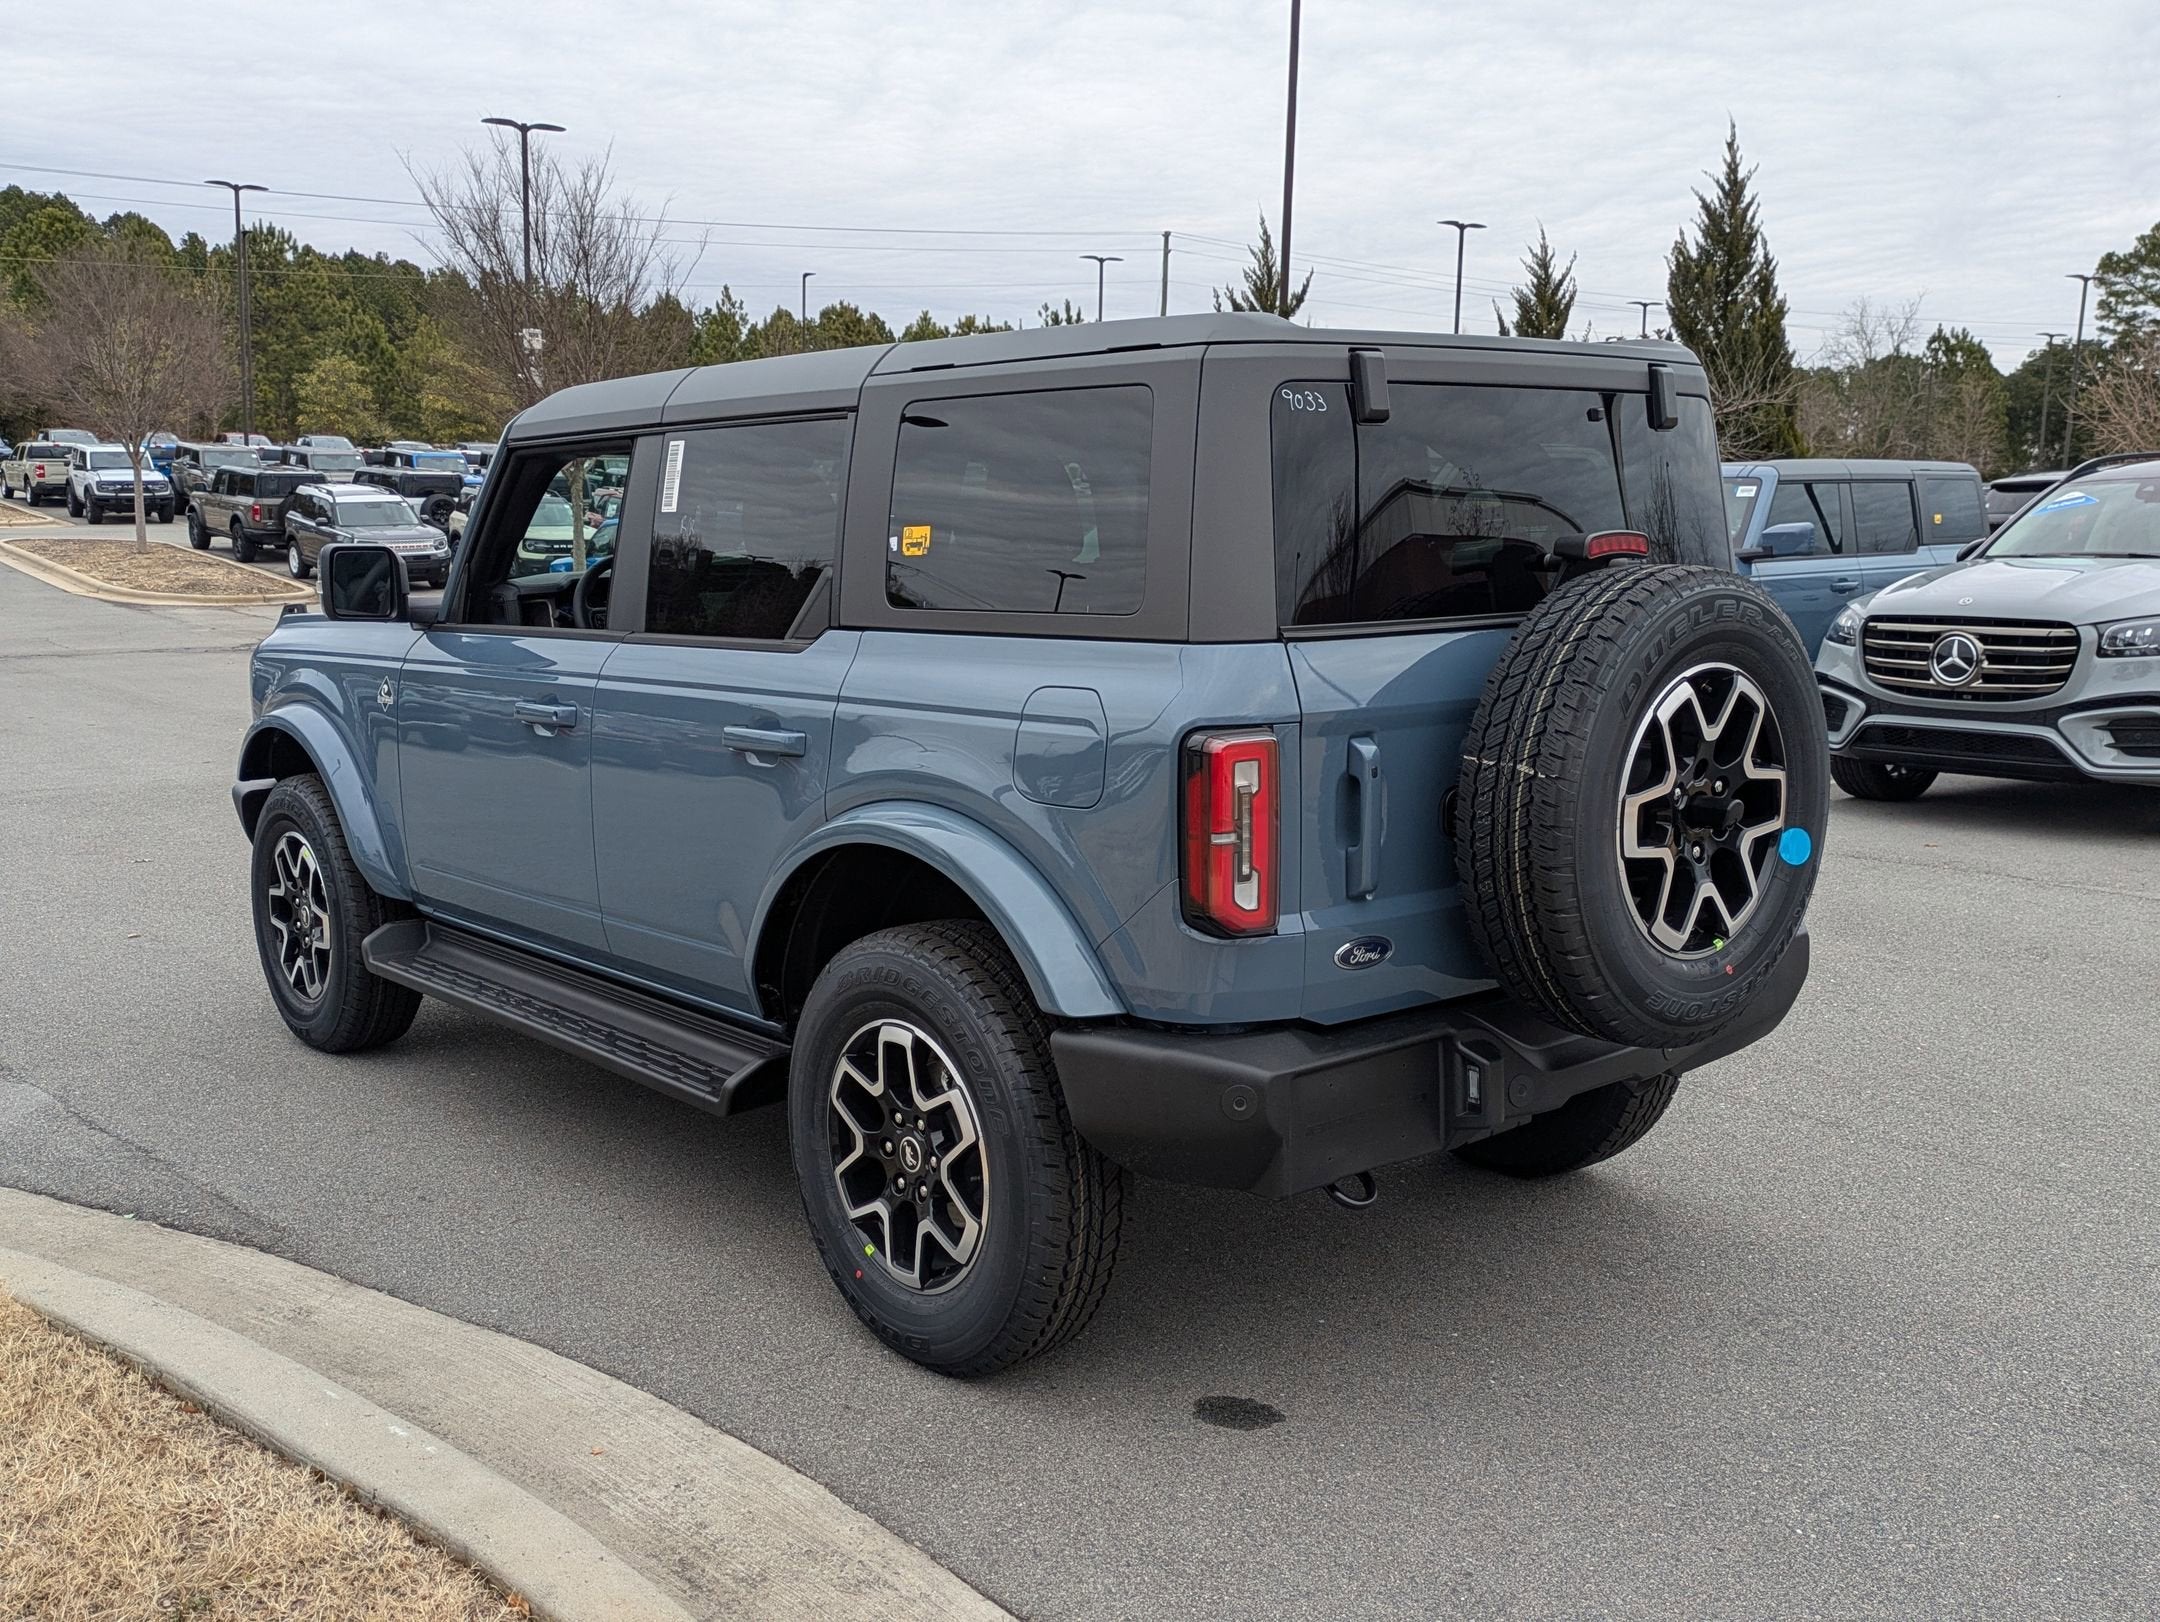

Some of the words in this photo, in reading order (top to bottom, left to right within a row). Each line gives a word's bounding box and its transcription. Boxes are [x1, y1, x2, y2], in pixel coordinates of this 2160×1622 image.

[1281, 389, 1327, 411] 9033
[1619, 599, 1764, 718] DUELER
[1350, 946, 1381, 964] Ford
[837, 966, 1010, 1137] BRIDGESTONE
